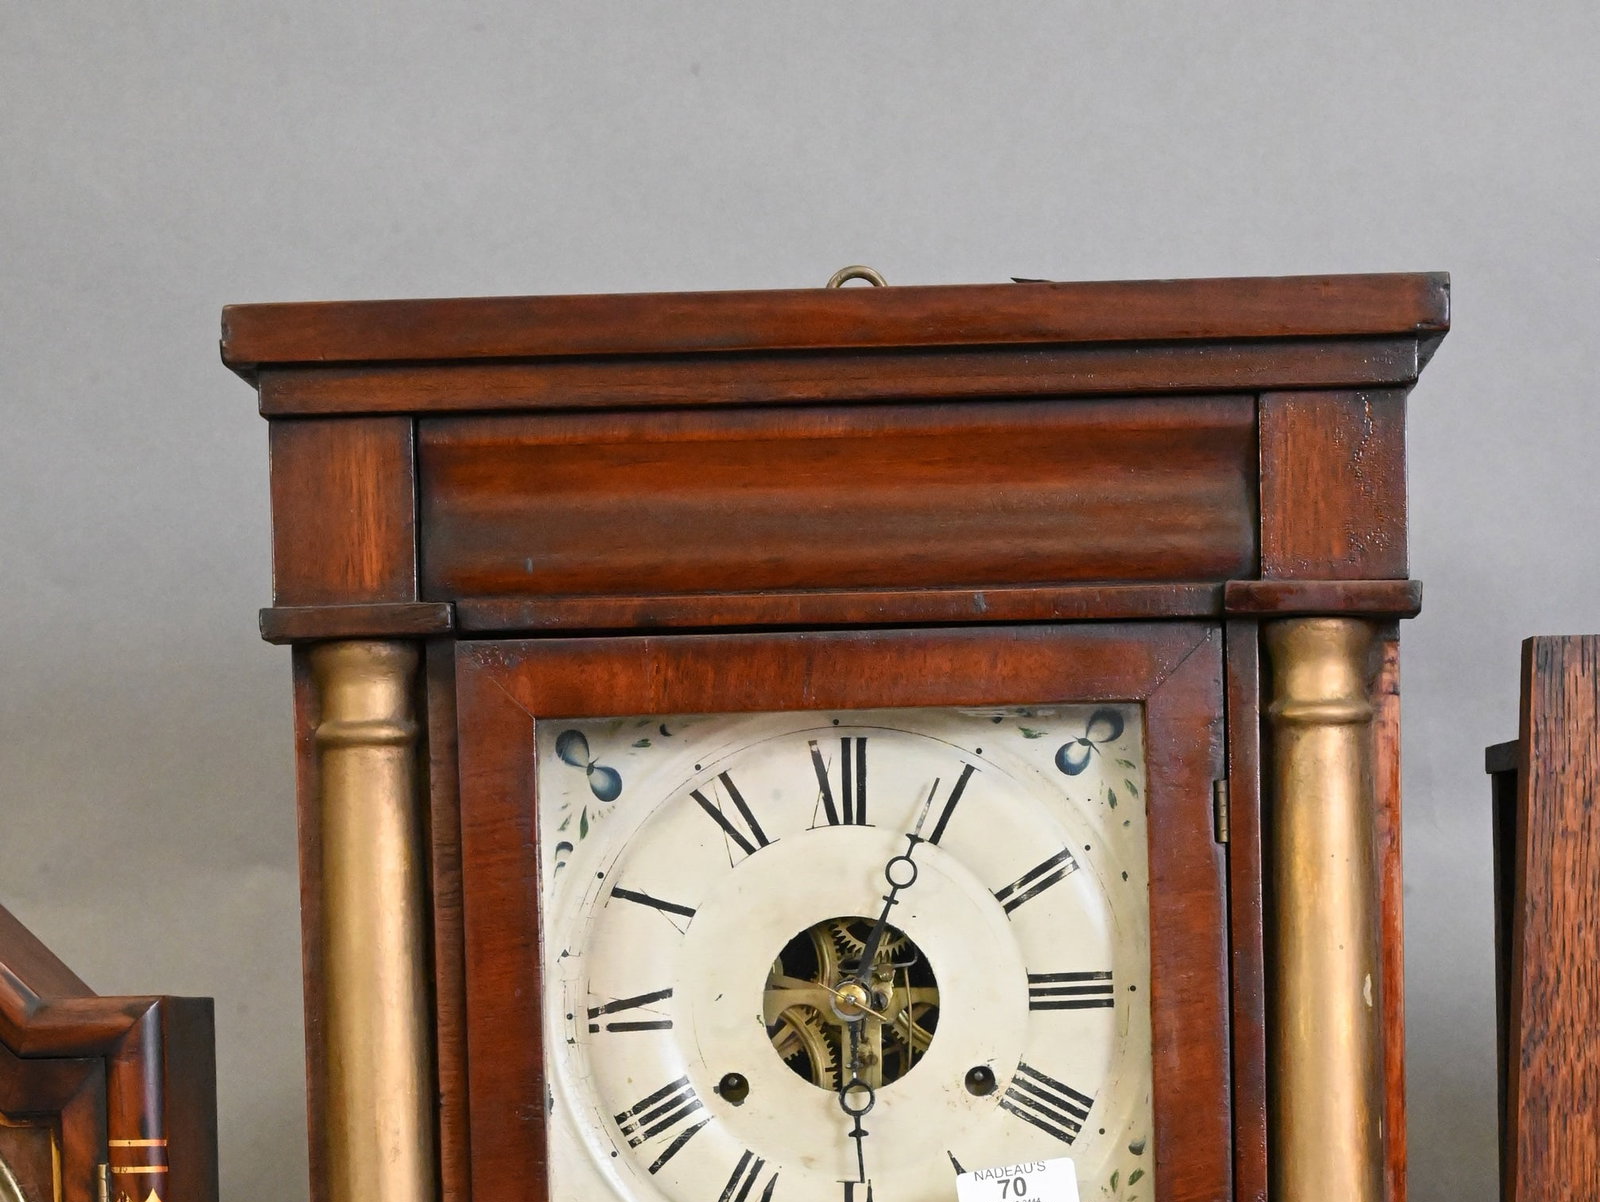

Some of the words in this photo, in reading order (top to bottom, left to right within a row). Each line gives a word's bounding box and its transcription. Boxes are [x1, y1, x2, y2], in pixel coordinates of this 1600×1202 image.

[1026, 968, 1114, 1011] III
[974, 1161, 1046, 1181] NADEAU'S
[997, 1177, 1027, 1199] 70
